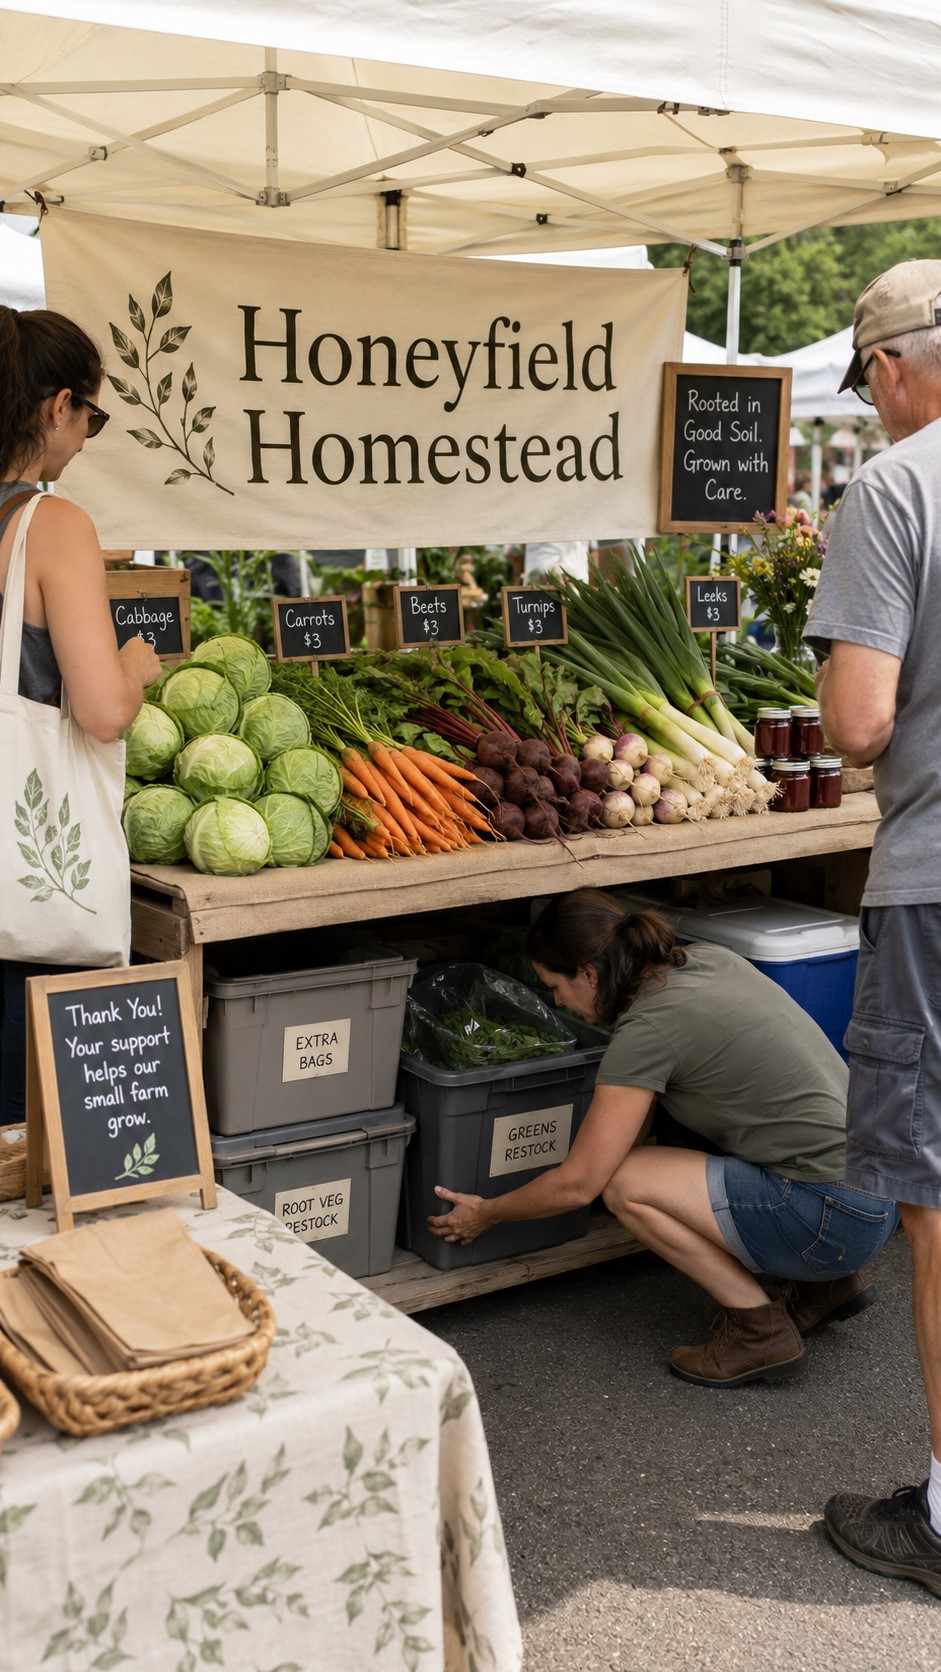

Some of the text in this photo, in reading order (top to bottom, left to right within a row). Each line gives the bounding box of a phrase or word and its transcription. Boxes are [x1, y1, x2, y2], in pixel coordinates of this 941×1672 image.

[238, 304, 618, 412] Honeyfield
[688, 389, 760, 413] Rooted in
[684, 419, 762, 442] Good Soil.
[243, 409, 623, 486] Homestead
[684, 449, 768, 473] Grown with
[705, 478, 746, 500] Care.
[411, 596, 446, 614] Beets
[698, 586, 727, 602] Leeks
[286, 609, 334, 627] Carrots
[512, 597, 555, 617] Turnips
[707, 607, 719, 621] $3
[116, 606, 174, 631] Cabbage
[424, 619, 438, 635] $3
[528, 619, 542, 633] $3
[304, 632, 321, 648] $3
[65, 995, 162, 1026] Thank You!
[65, 1026, 170, 1058] Your support
[297, 1032, 338, 1050] EXTRA
[300, 1053, 332, 1069] BAGS
[84, 1060, 160, 1086] helps our
[85, 1082, 168, 1109] small farm
[108, 1112, 151, 1139] grow.
[509, 1121, 556, 1141] GREENS
[505, 1140, 556, 1161] RESTOCK
[283, 1193, 343, 1216] ROOT VEG
